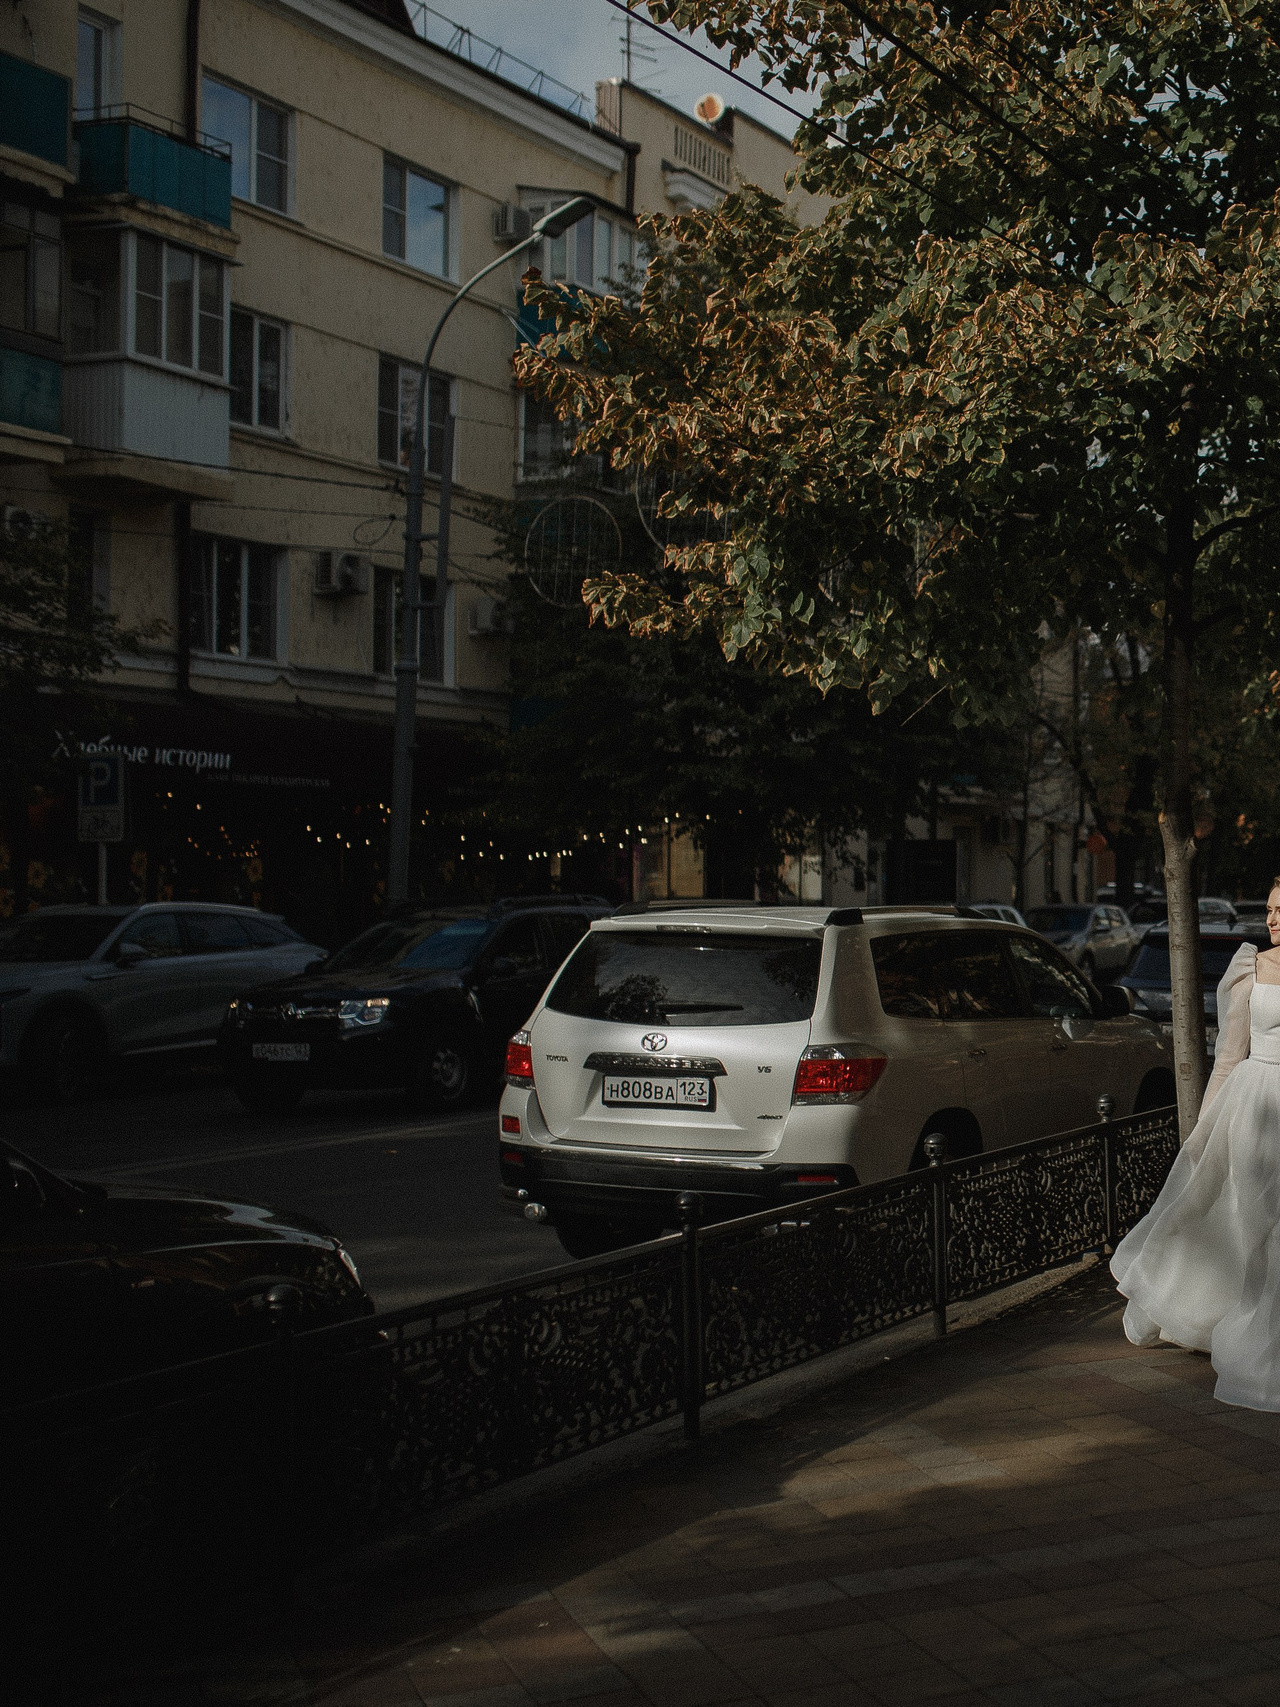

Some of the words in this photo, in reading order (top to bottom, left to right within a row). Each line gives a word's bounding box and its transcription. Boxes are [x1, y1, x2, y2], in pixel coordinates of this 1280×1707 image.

[154, 747, 231, 775] истории
[546, 1054, 569, 1063] TOYOTA
[609, 1080, 675, 1101] Н808ВА
[679, 1081, 705, 1096] 123
